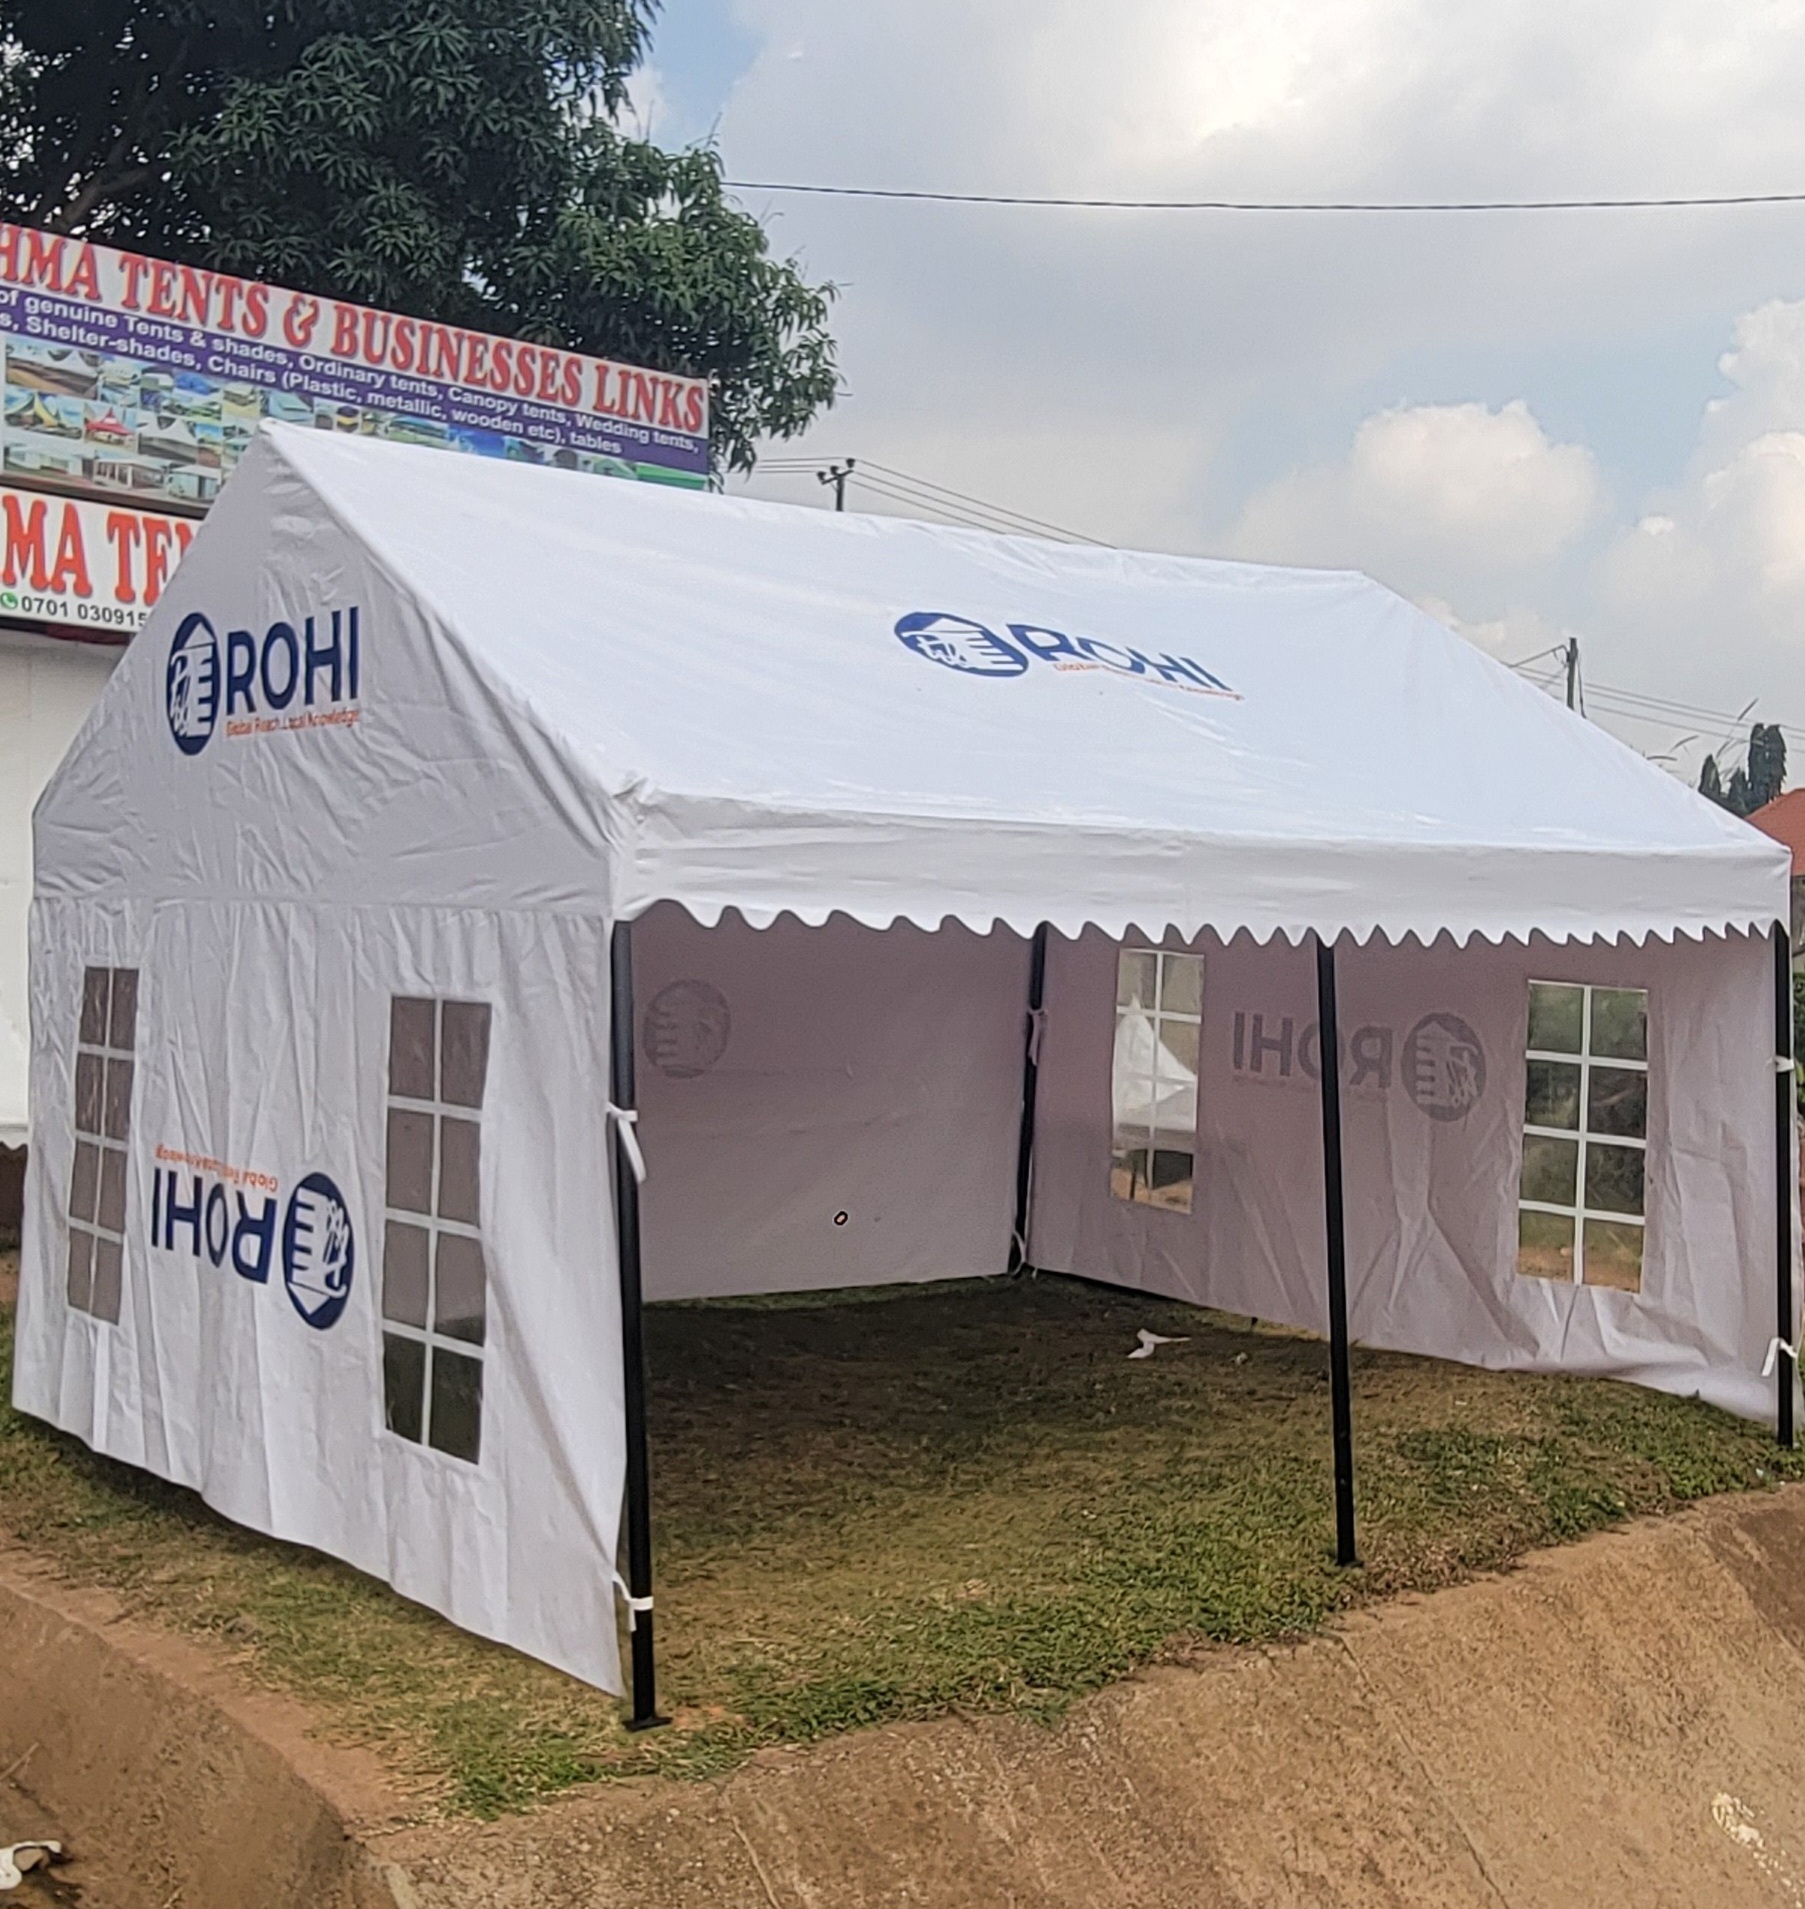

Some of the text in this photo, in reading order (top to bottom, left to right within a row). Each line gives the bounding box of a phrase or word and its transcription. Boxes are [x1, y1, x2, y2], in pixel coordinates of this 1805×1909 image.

[25, 296, 118, 328] genuine
[124, 314, 184, 343] Tents
[189, 330, 207, 348] &
[212, 337, 294, 370] shades,
[299, 354, 387, 389] Ordinary
[389, 374, 444, 400] tents,
[448, 387, 518, 416] Canopy
[522, 402, 572, 427] tents,
[576, 413, 650, 444] Wedding
[653, 430, 699, 454] tents,
[26, 315, 202, 371] Shelter-shades,
[207, 355, 277, 383] Chairs
[281, 370, 363, 404] (Plastic,
[366, 391, 447, 421] metallic,
[451, 408, 524, 434] wooden
[527, 423, 567, 445] etc),
[570, 431, 623, 454] tables
[119, 253, 269, 338] TENTS
[283, 294, 320, 348] &
[330, 303, 583, 408] BUSINESSES
[592, 364, 705, 433] LINKS
[2, 494, 193, 607] MA TE
[21, 595, 69, 618] 0701
[226, 606, 359, 716] ROHI
[1006, 622, 1234, 692] ROHI
[151, 1166, 278, 1286] ROHI
